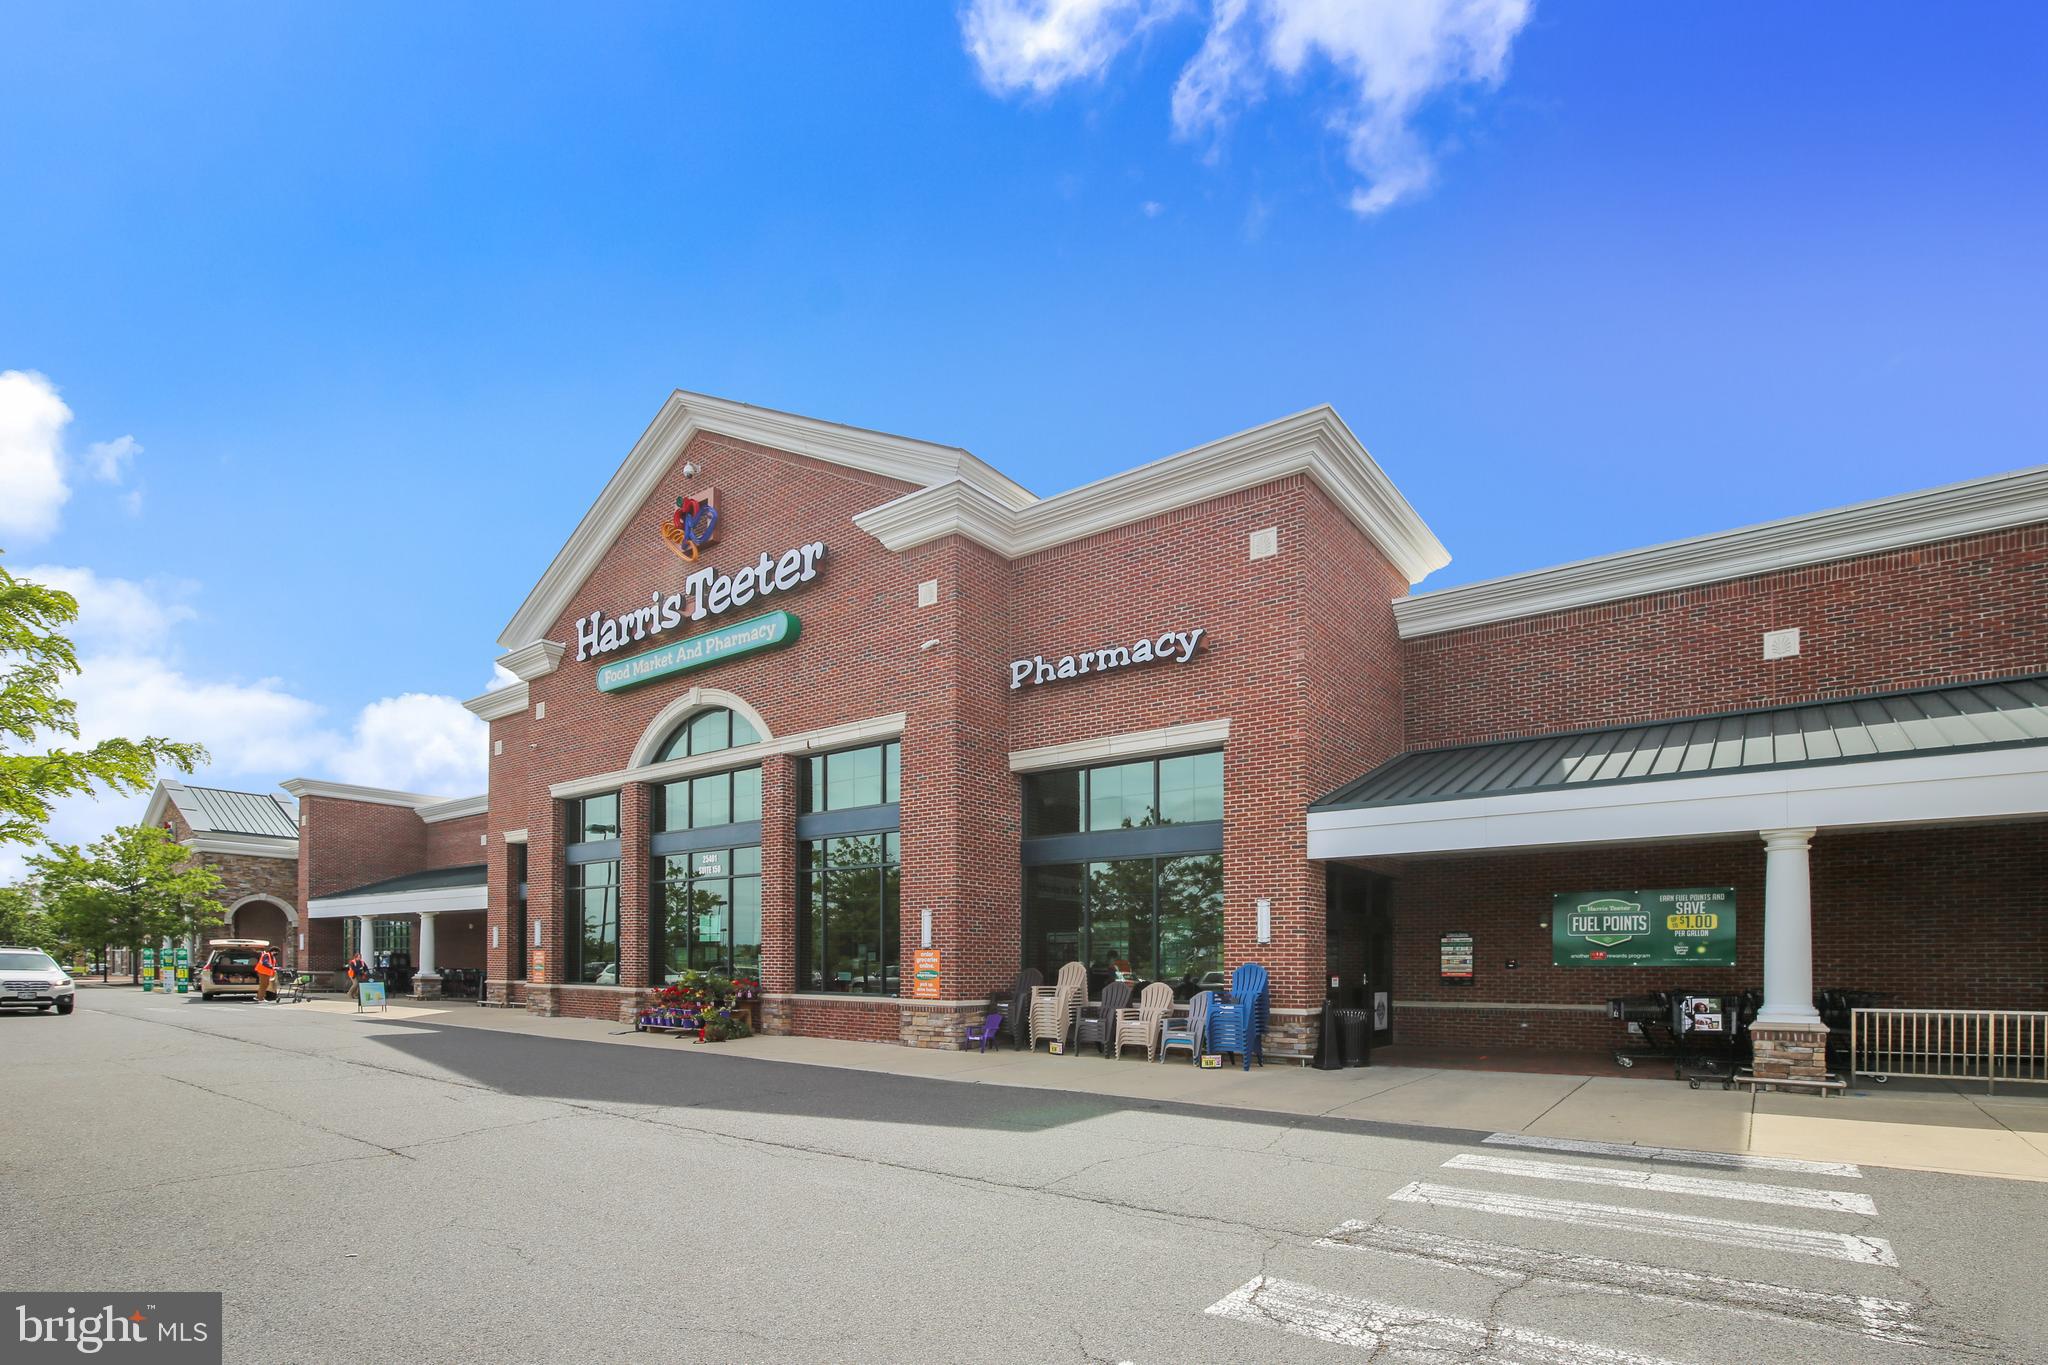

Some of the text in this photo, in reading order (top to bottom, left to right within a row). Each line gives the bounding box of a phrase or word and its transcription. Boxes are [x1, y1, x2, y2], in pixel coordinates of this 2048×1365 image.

[575, 541, 825, 662] Harris Teeter
[604, 622, 777, 685] Food Market And Pharmacy
[1009, 628, 1205, 690] Pharmacy
[699, 865, 711, 875] SUITE
[1659, 894, 1675, 902] EARN
[1690, 893, 1711, 901] POINTS
[1675, 901, 1706, 914] SAVE
[1572, 915, 1647, 931] FUEL POINTS
[1679, 915, 1712, 928] $1.00
